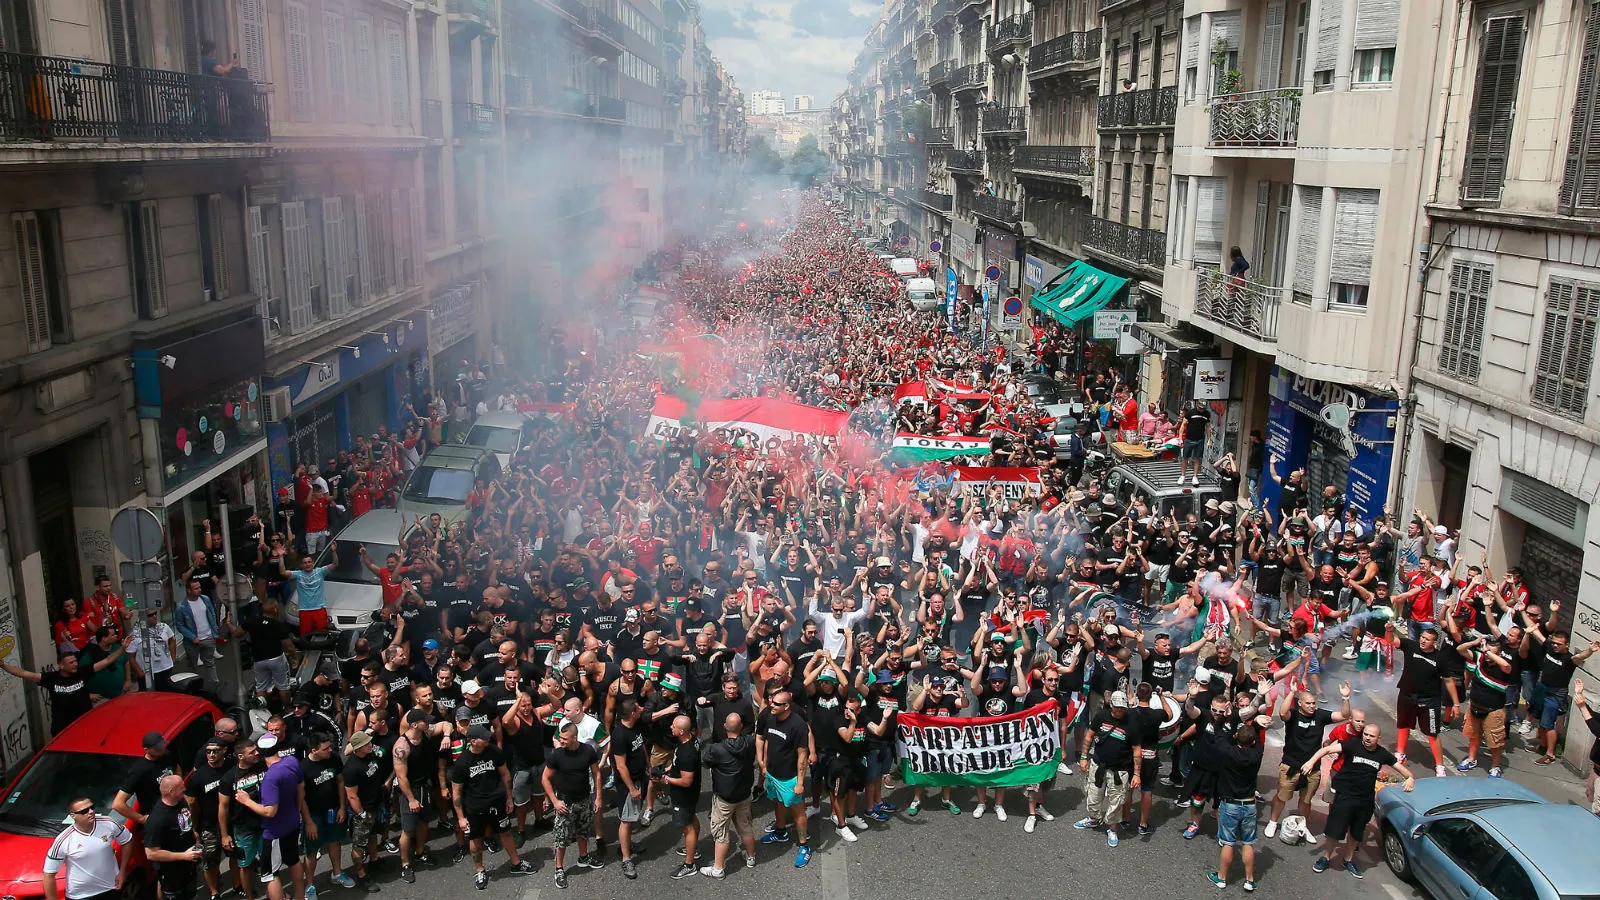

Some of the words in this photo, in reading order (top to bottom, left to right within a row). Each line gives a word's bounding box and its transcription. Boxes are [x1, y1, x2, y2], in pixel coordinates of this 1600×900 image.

[902, 437, 979, 449] TOKAJ
[972, 481, 1027, 498] SZÉNY
[594, 615, 618, 624] MUSCLE
[898, 709, 1055, 750] CARPATHIAN
[908, 748, 1013, 774] BRIGADE
[1020, 738, 1055, 765] '09
